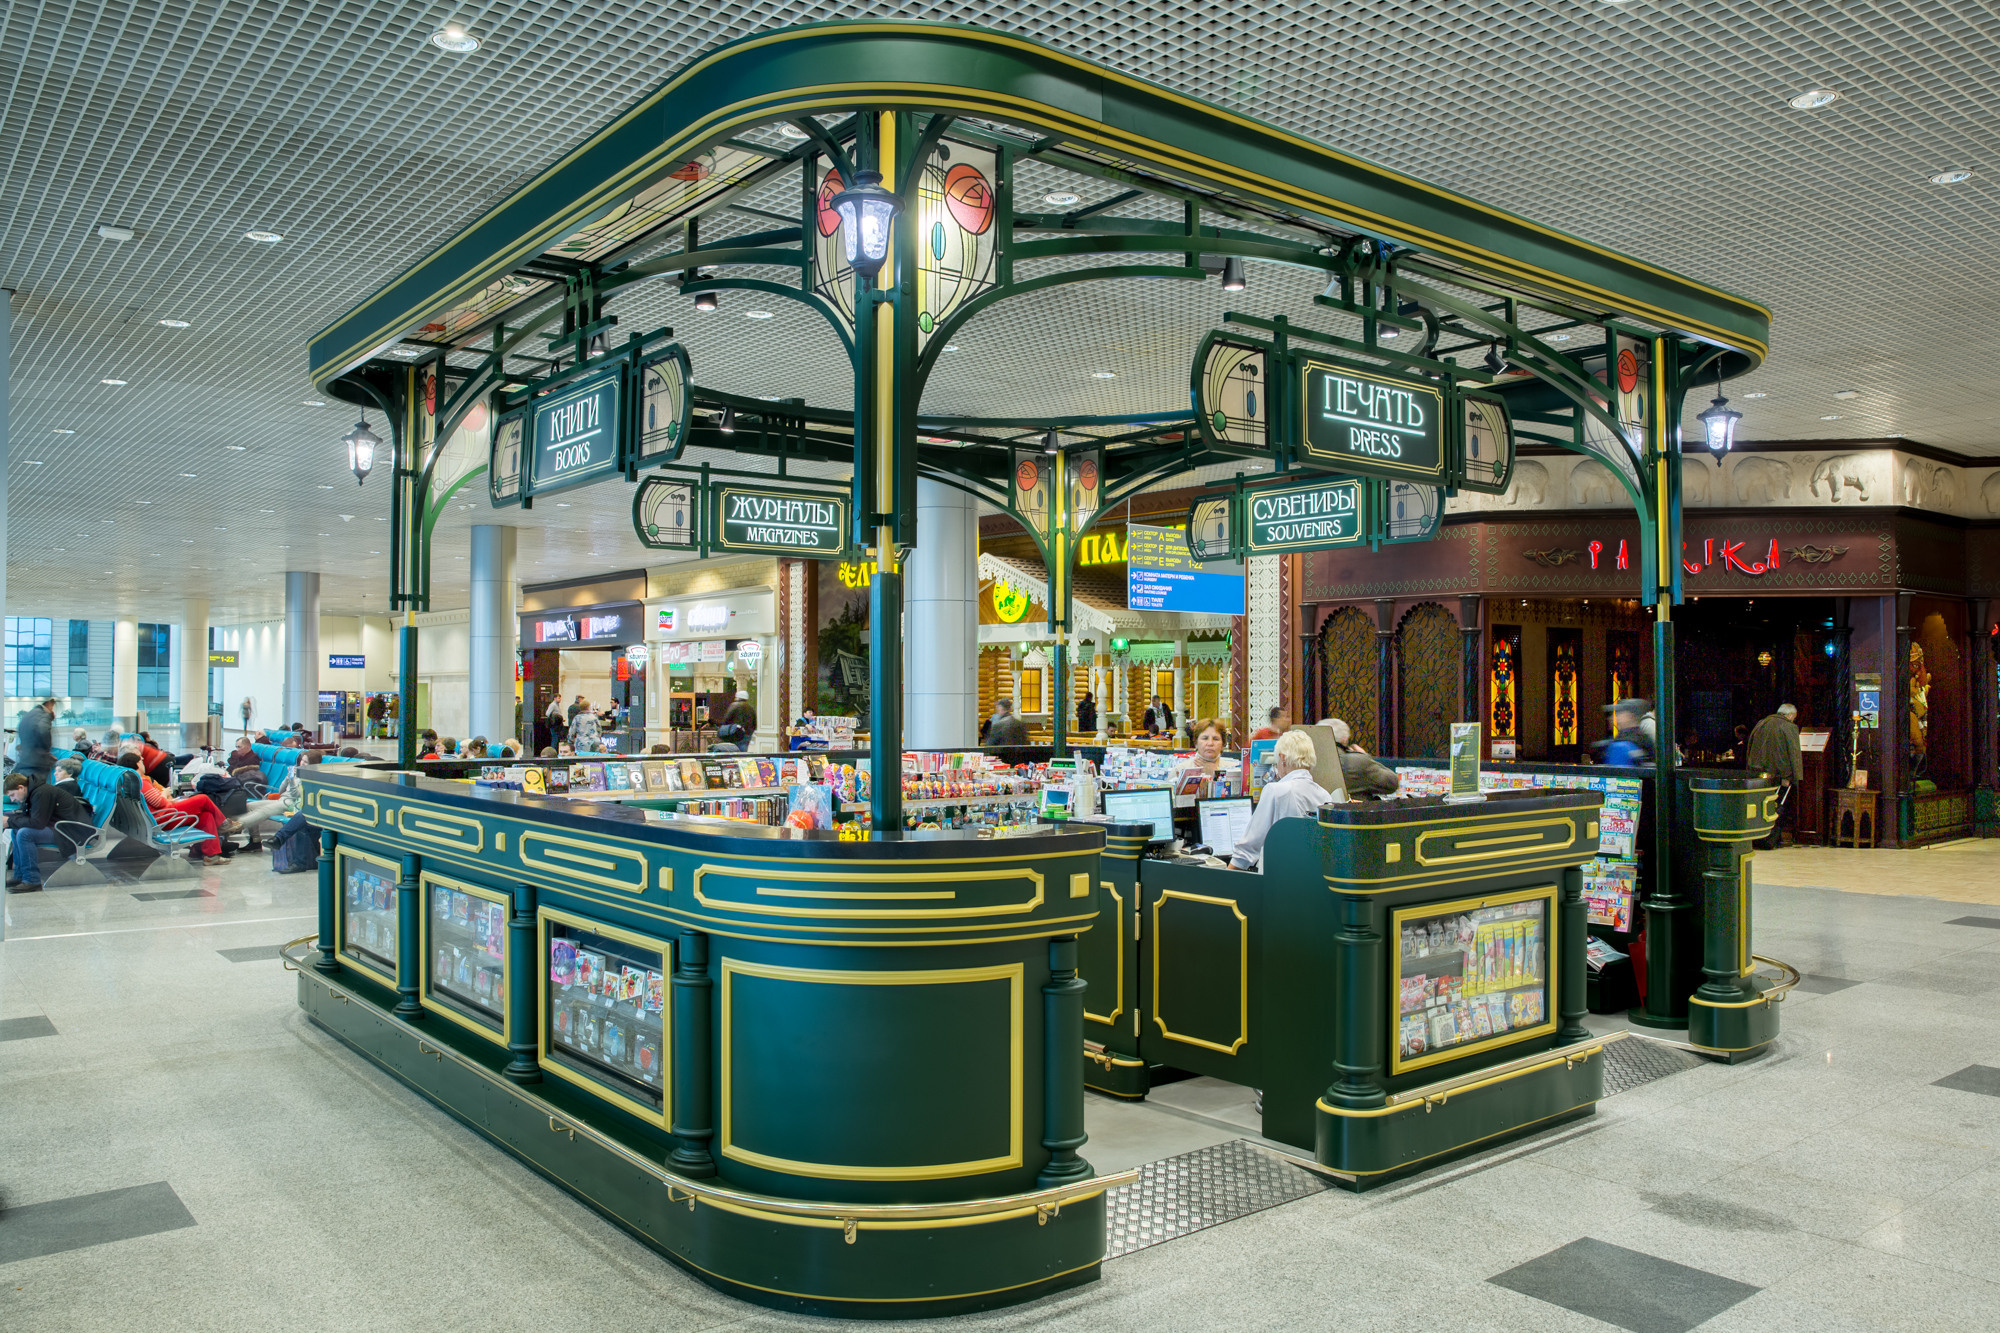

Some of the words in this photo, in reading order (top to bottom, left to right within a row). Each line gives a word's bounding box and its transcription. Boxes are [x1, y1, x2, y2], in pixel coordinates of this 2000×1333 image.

[1323, 374, 1424, 428] ПЕЧАТЬ
[550, 393, 600, 442] КНИГИ
[555, 440, 591, 472] BOOKS
[1350, 426, 1401, 458] PRESS
[731, 496, 835, 526] ЖУРНАЛЫ
[1254, 487, 1356, 521] СУВЕНИРЫ
[746, 526, 820, 546] MAGAZINES
[1267, 519, 1342, 542] SOUVENIRS
[1188, 560, 1203, 569] 1-22
[740, 649, 760, 658] sbarro
[1600, 825, 1631, 833] СКАНВОРДОВ
